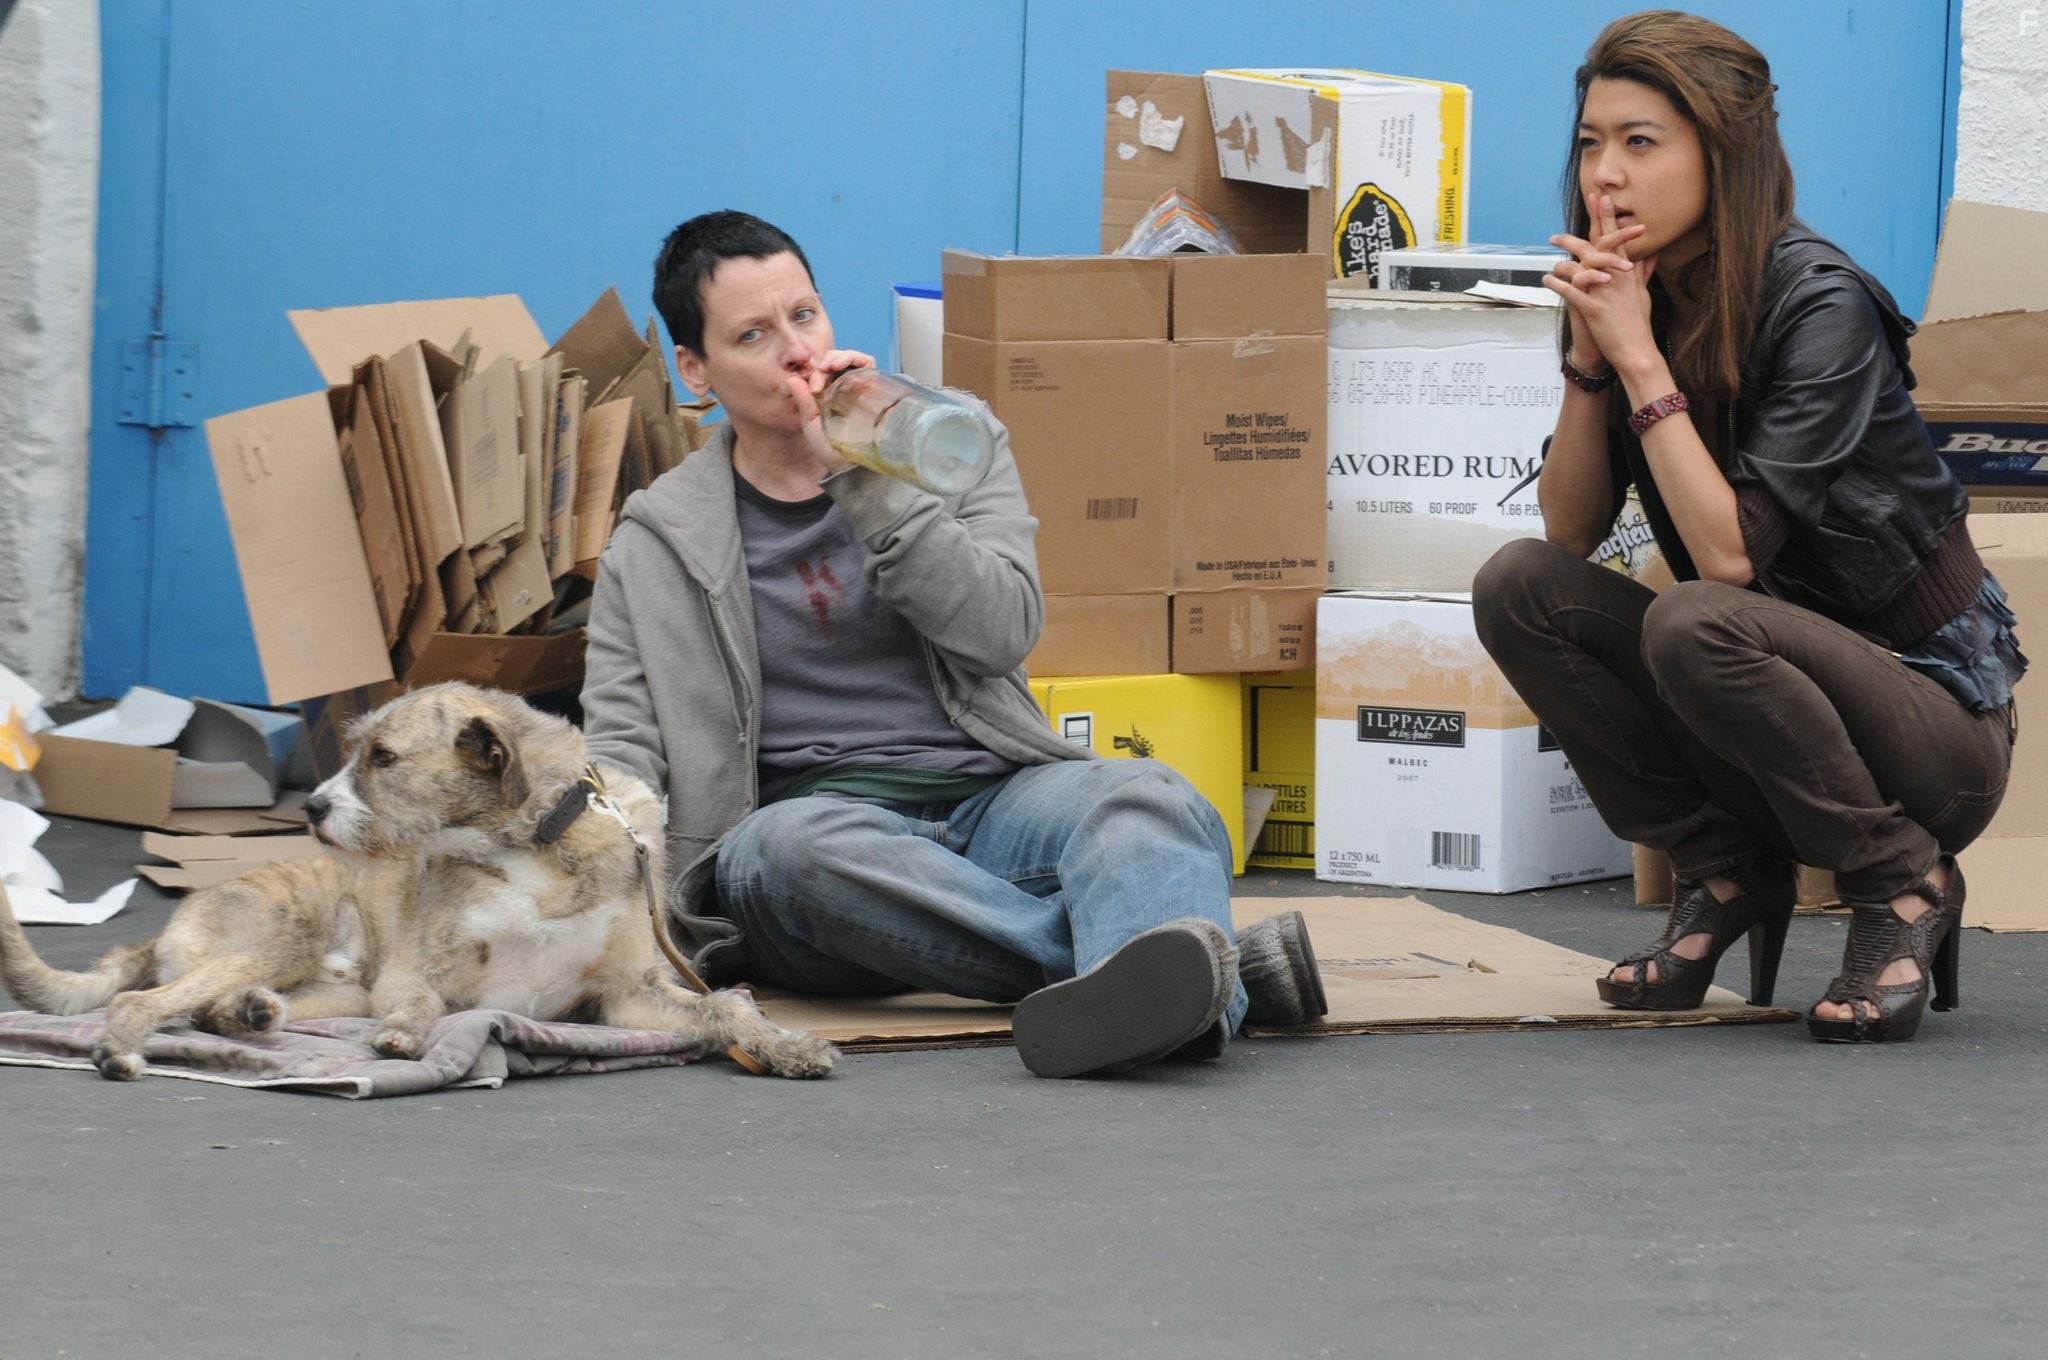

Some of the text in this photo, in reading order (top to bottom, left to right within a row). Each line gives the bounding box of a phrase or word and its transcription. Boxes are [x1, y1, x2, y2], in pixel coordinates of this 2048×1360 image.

[1226, 412, 1289, 429] Moist Wipes/
[1204, 431, 1248, 448] Lingettes
[1213, 446, 1254, 462] Toallitas
[1327, 454, 1536, 479] AVORED RUM
[1356, 500, 1378, 512] 10.5
[1380, 500, 1413, 514] LITERS
[1429, 502, 1442, 514] 60
[1445, 502, 1477, 515] PROOF
[1389, 757, 1429, 767] MALBEC
[1271, 800, 1306, 814] LITRES
[1329, 850, 1338, 860] 12
[1346, 852, 1363, 862] 750
[1366, 854, 1380, 864] ML
[1337, 870, 1373, 878] ARGENTINA
